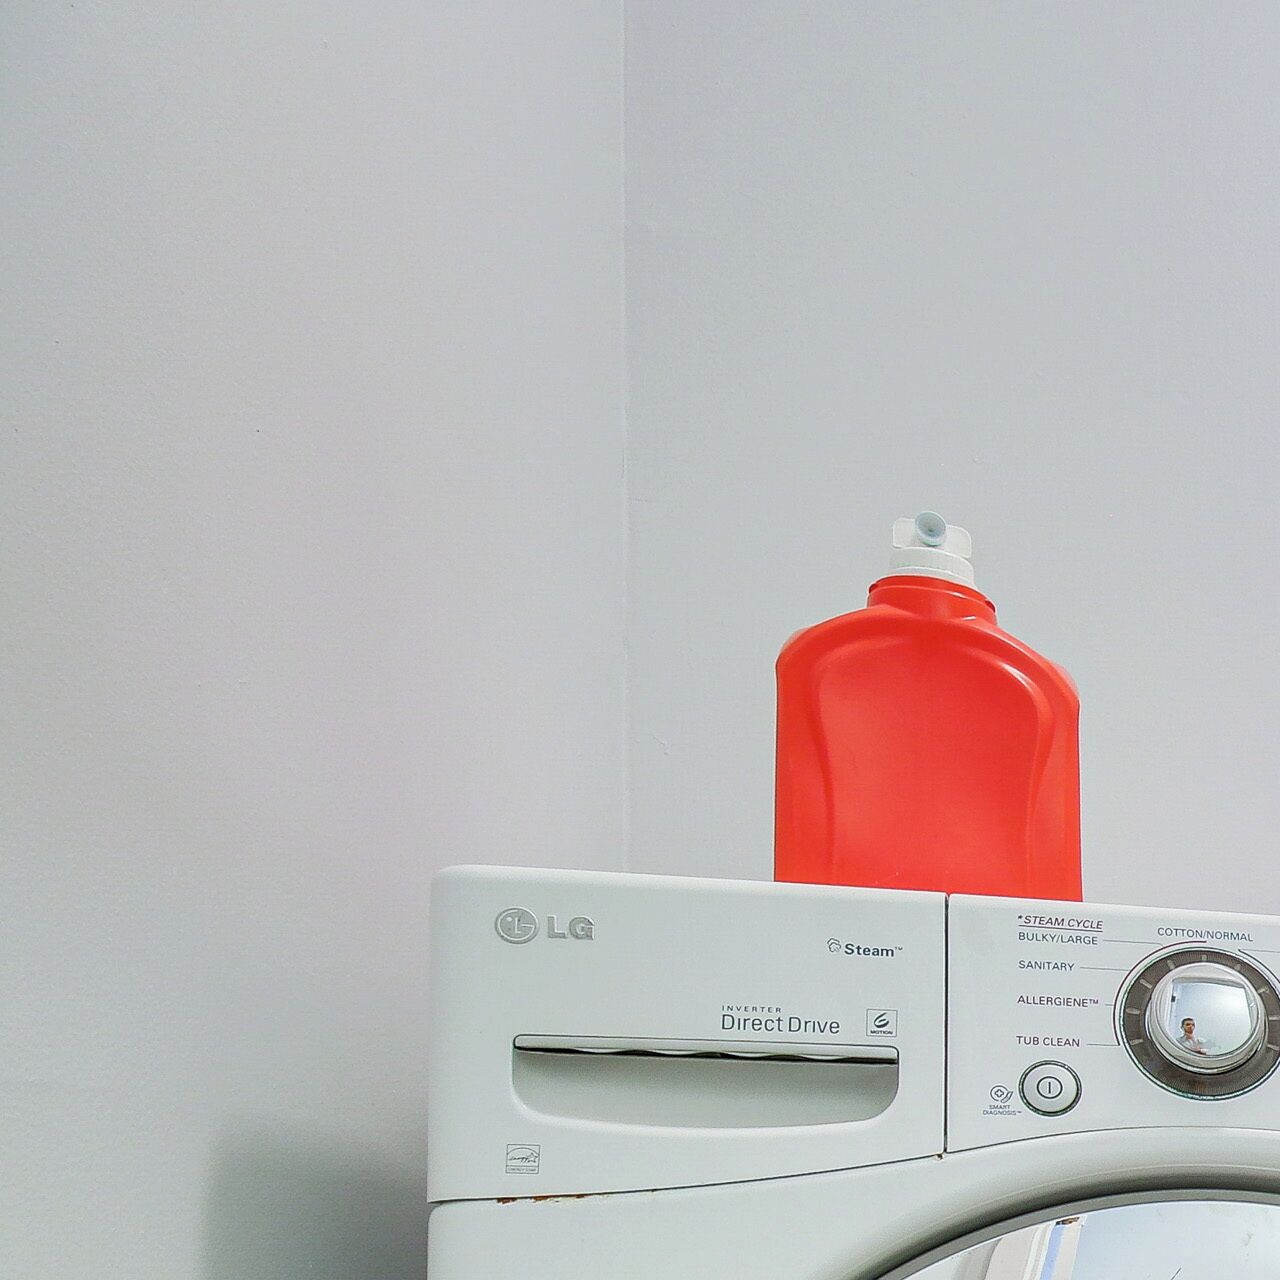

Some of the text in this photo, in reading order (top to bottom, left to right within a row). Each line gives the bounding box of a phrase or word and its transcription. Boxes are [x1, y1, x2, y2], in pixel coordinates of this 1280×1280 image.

[546, 914, 596, 941] LG
[1067, 918, 1104, 930] CYCLE
[1018, 931, 1099, 946] BULKY/LARGE
[1157, 927, 1254, 942] COTTON/NORMAL
[1018, 960, 1075, 972] SANITARY
[721, 1005, 782, 1013] INVERTER
[721, 1013, 841, 1034] Direct Drive
[1016, 1035, 1081, 1047] TUB CLEAN
